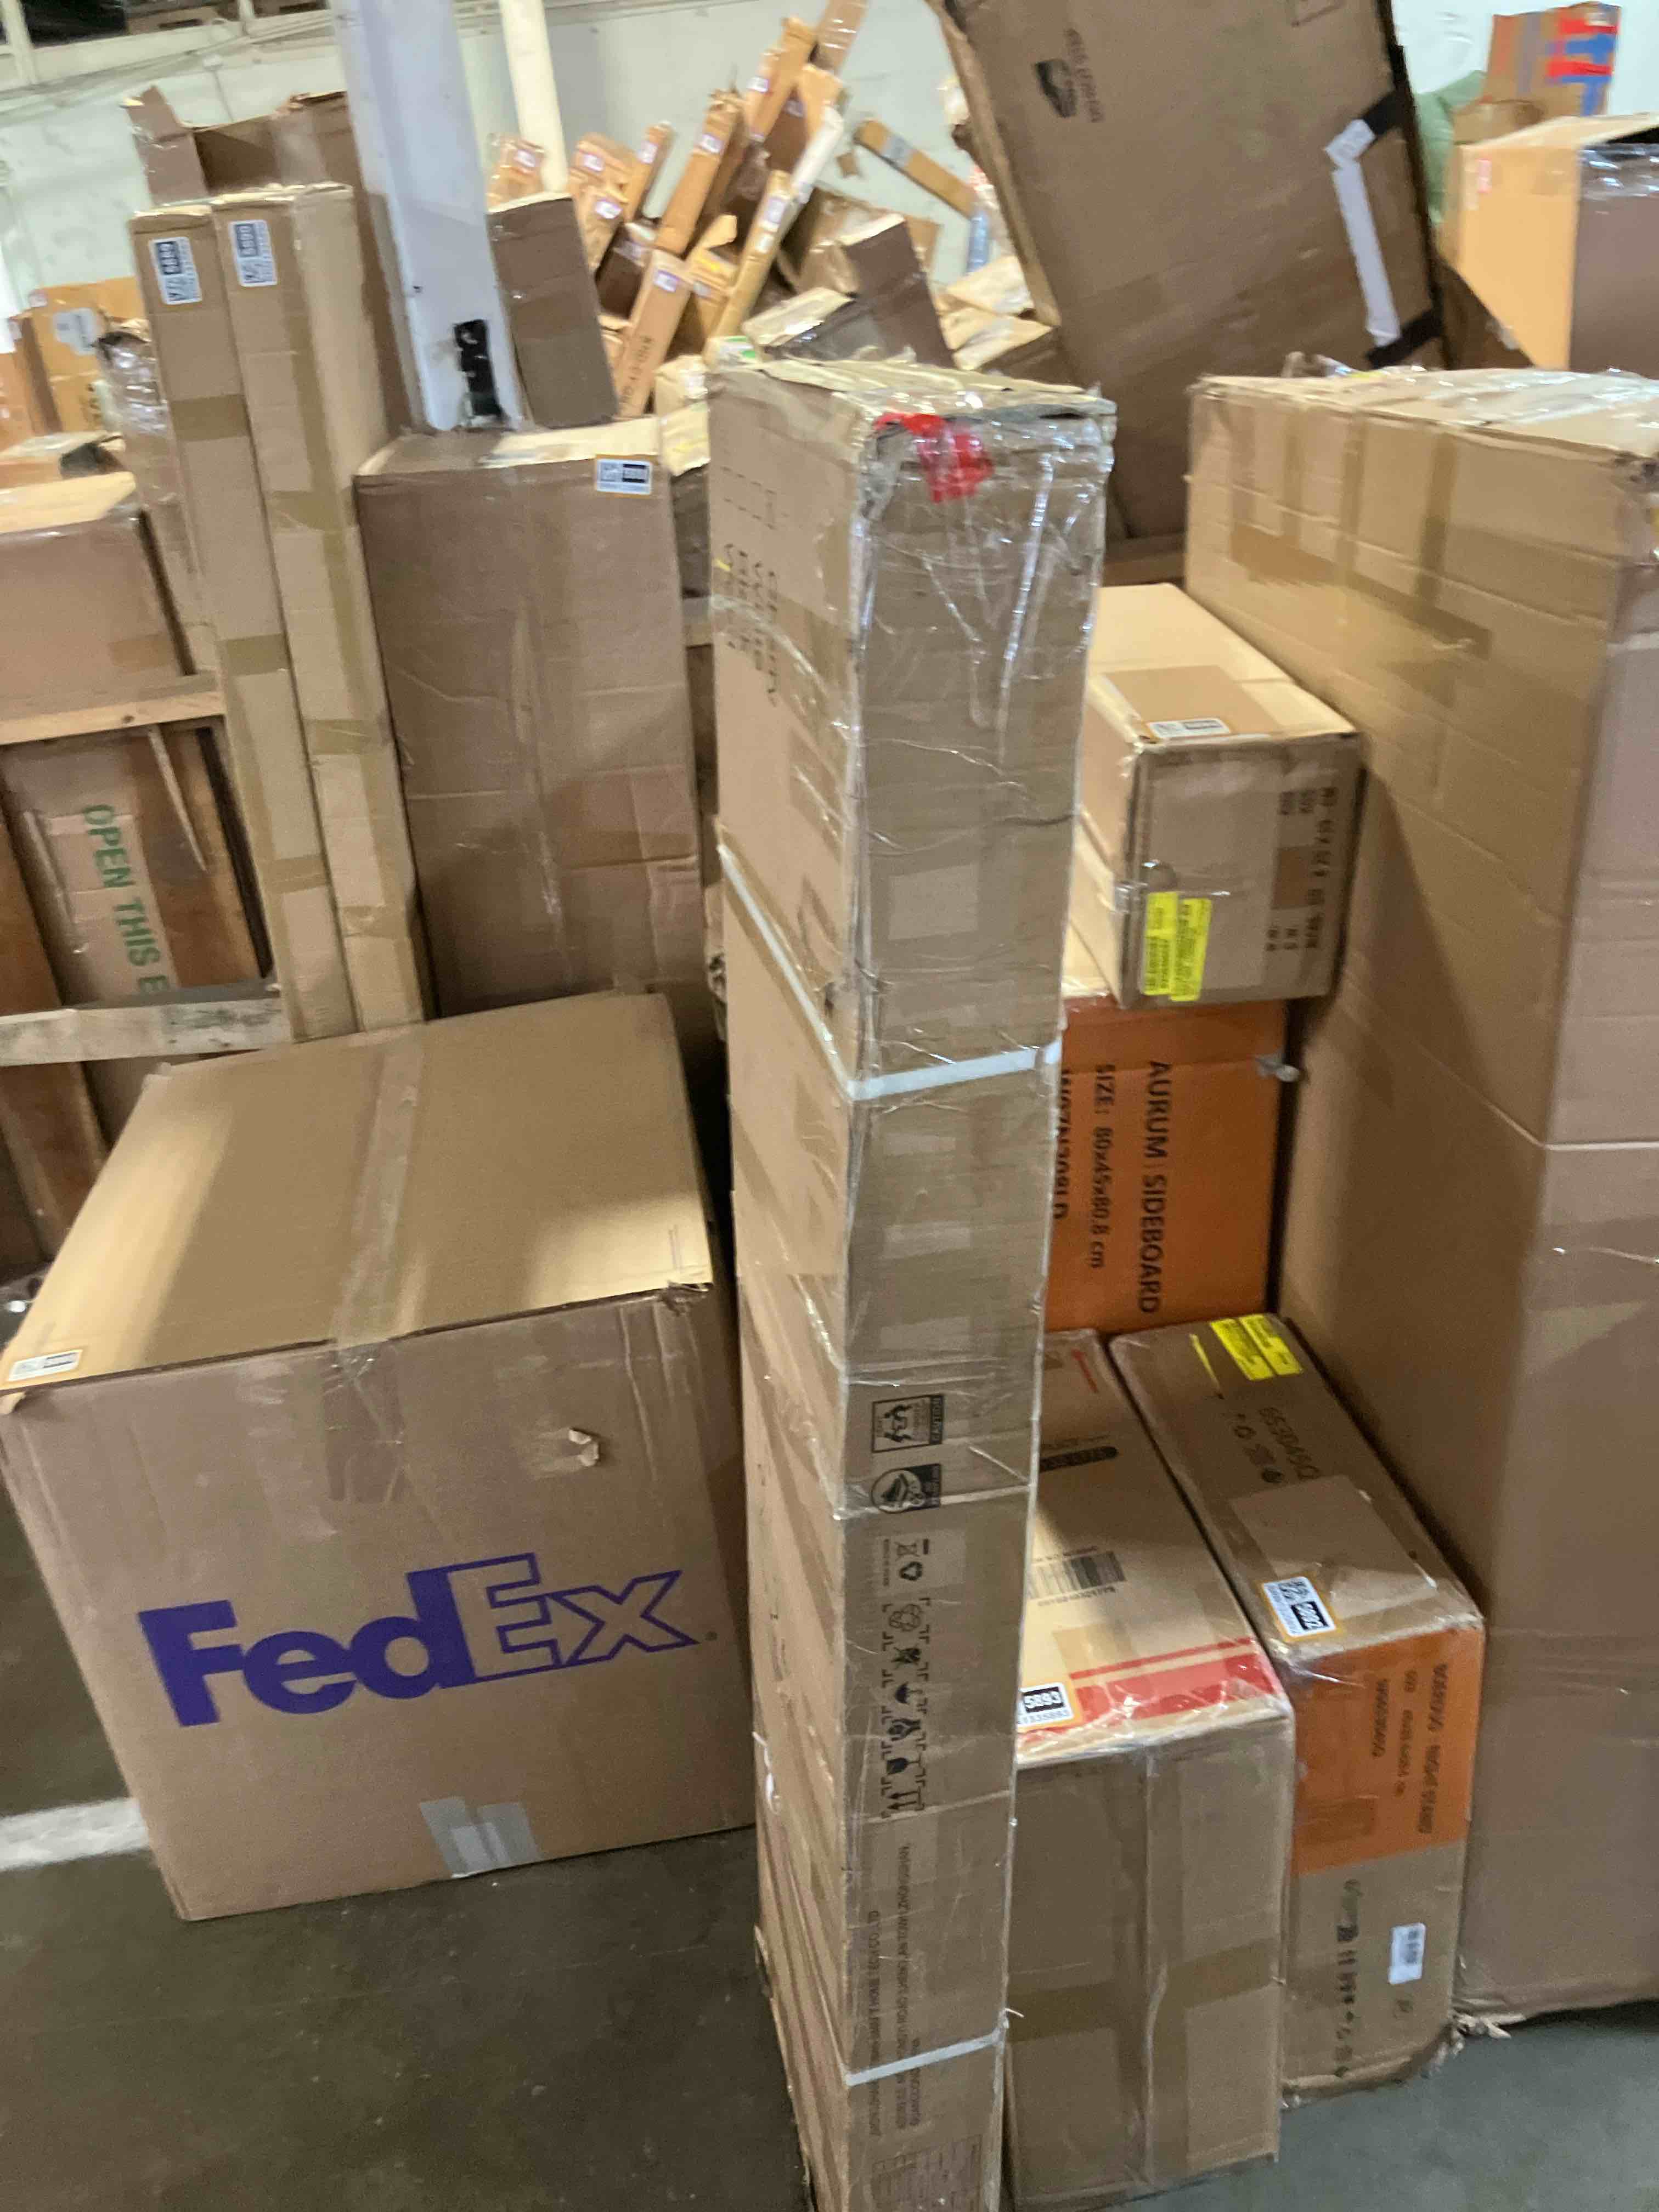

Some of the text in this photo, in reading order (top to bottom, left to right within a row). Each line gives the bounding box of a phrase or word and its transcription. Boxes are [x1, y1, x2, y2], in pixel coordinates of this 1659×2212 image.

[83, 804, 136, 888] OPEN
[114, 896, 161, 966] THIS
[1138, 1061, 1171, 1313] AURUM SIDEBOARD
[137, 1552, 700, 1727] FedEx
